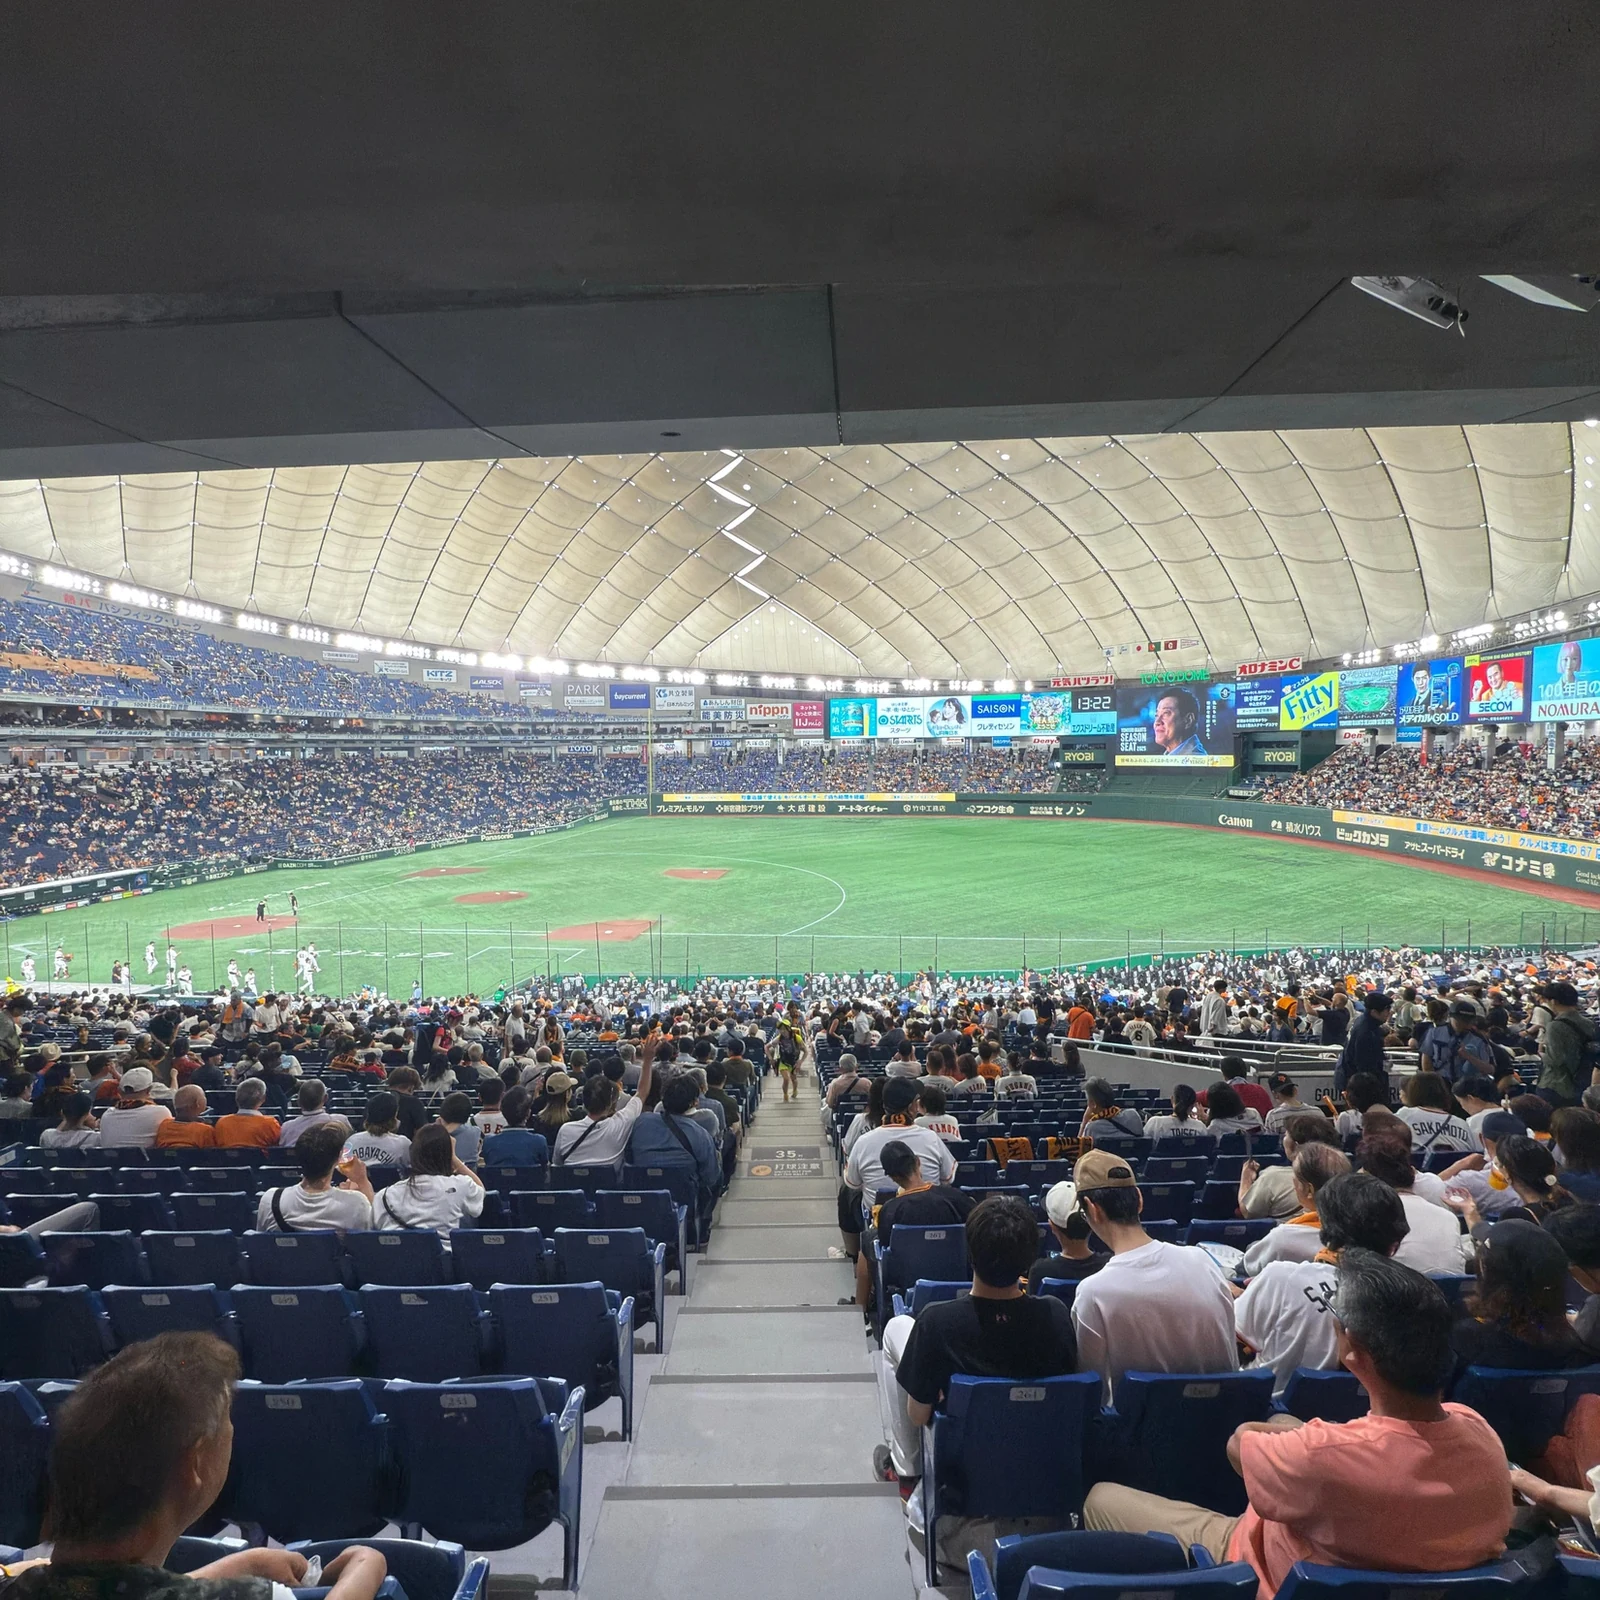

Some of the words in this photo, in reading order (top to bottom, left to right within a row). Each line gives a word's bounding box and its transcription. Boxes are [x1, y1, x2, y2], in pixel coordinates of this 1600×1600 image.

[99, 602, 202, 631] パシフィック・リーグ
[1238, 657, 1300, 675] オロナミンC
[1140, 670, 1177, 685] TOKYO
[1176, 668, 1210, 682] DOME
[1292, 676, 1310, 689] マスクは
[568, 684, 600, 694] PARK
[614, 692, 646, 700] baycurrent
[1284, 680, 1332, 720] Fitty
[1078, 696, 1111, 709] 13:22
[1479, 701, 1512, 712] SECOM
[750, 704, 788, 717] nippn
[977, 704, 1015, 714] SAISON
[1538, 702, 1600, 717] NOMURA
[702, 711, 743, 720] 能美防災
[890, 715, 922, 725] STARTS
[1121, 733, 1146, 742] SEASON
[1120, 743, 1136, 752] SEAT
[1064, 752, 1094, 761] RYOBI
[1264, 752, 1295, 762] RYOBI
[788, 804, 826, 813] 大成建設
[1054, 807, 1085, 815] セノン
[1218, 814, 1253, 828] Canon
[1286, 821, 1321, 837] 積水ハウス
[481, 833, 514, 841] Panasonic
[1336, 827, 1389, 847] ビックカメラ
[1404, 841, 1465, 860] アサヒスーパードライ
[1502, 855, 1542, 876] コナミ
[1136, 1031, 1142, 1041] 6
[1412, 1123, 1468, 1140] SAKAMOTO
